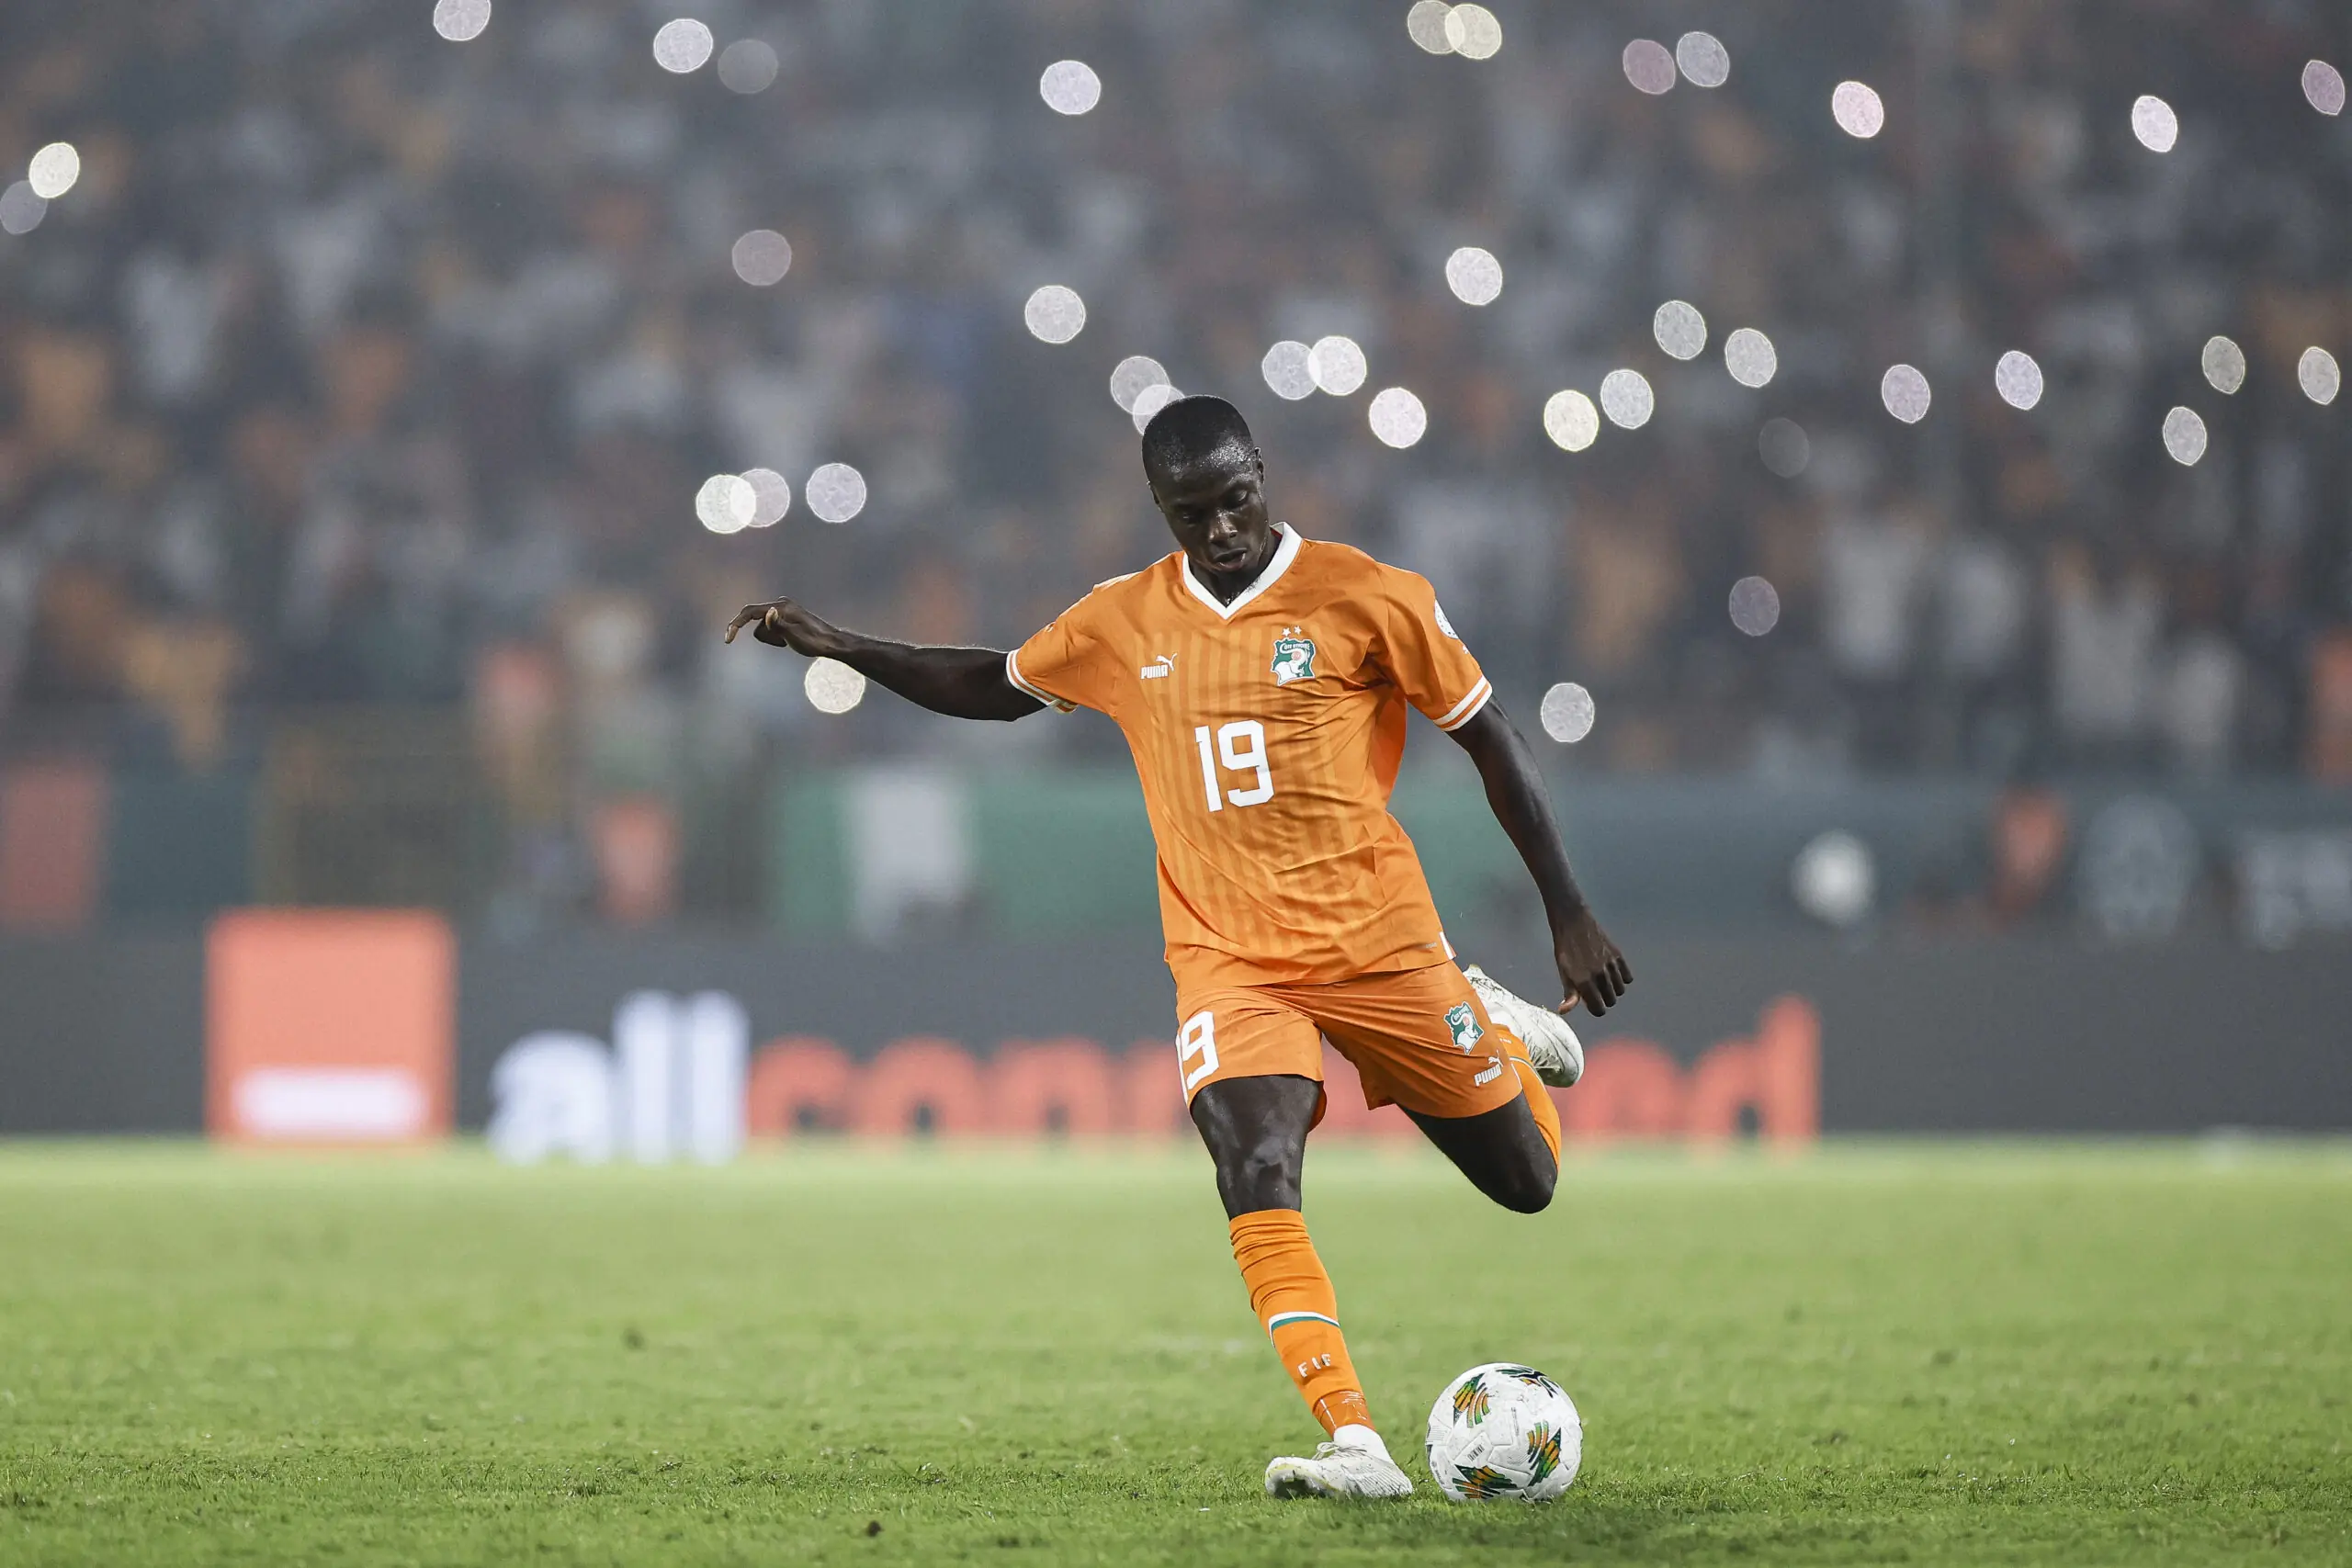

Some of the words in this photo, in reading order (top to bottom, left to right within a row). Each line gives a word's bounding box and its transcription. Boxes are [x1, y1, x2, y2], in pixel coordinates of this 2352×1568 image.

[1140, 664, 1169, 680] PUMA
[1195, 719, 1274, 812] 19
[491, 990, 749, 1162] all
[1474, 1063, 1502, 1088] PUMA
